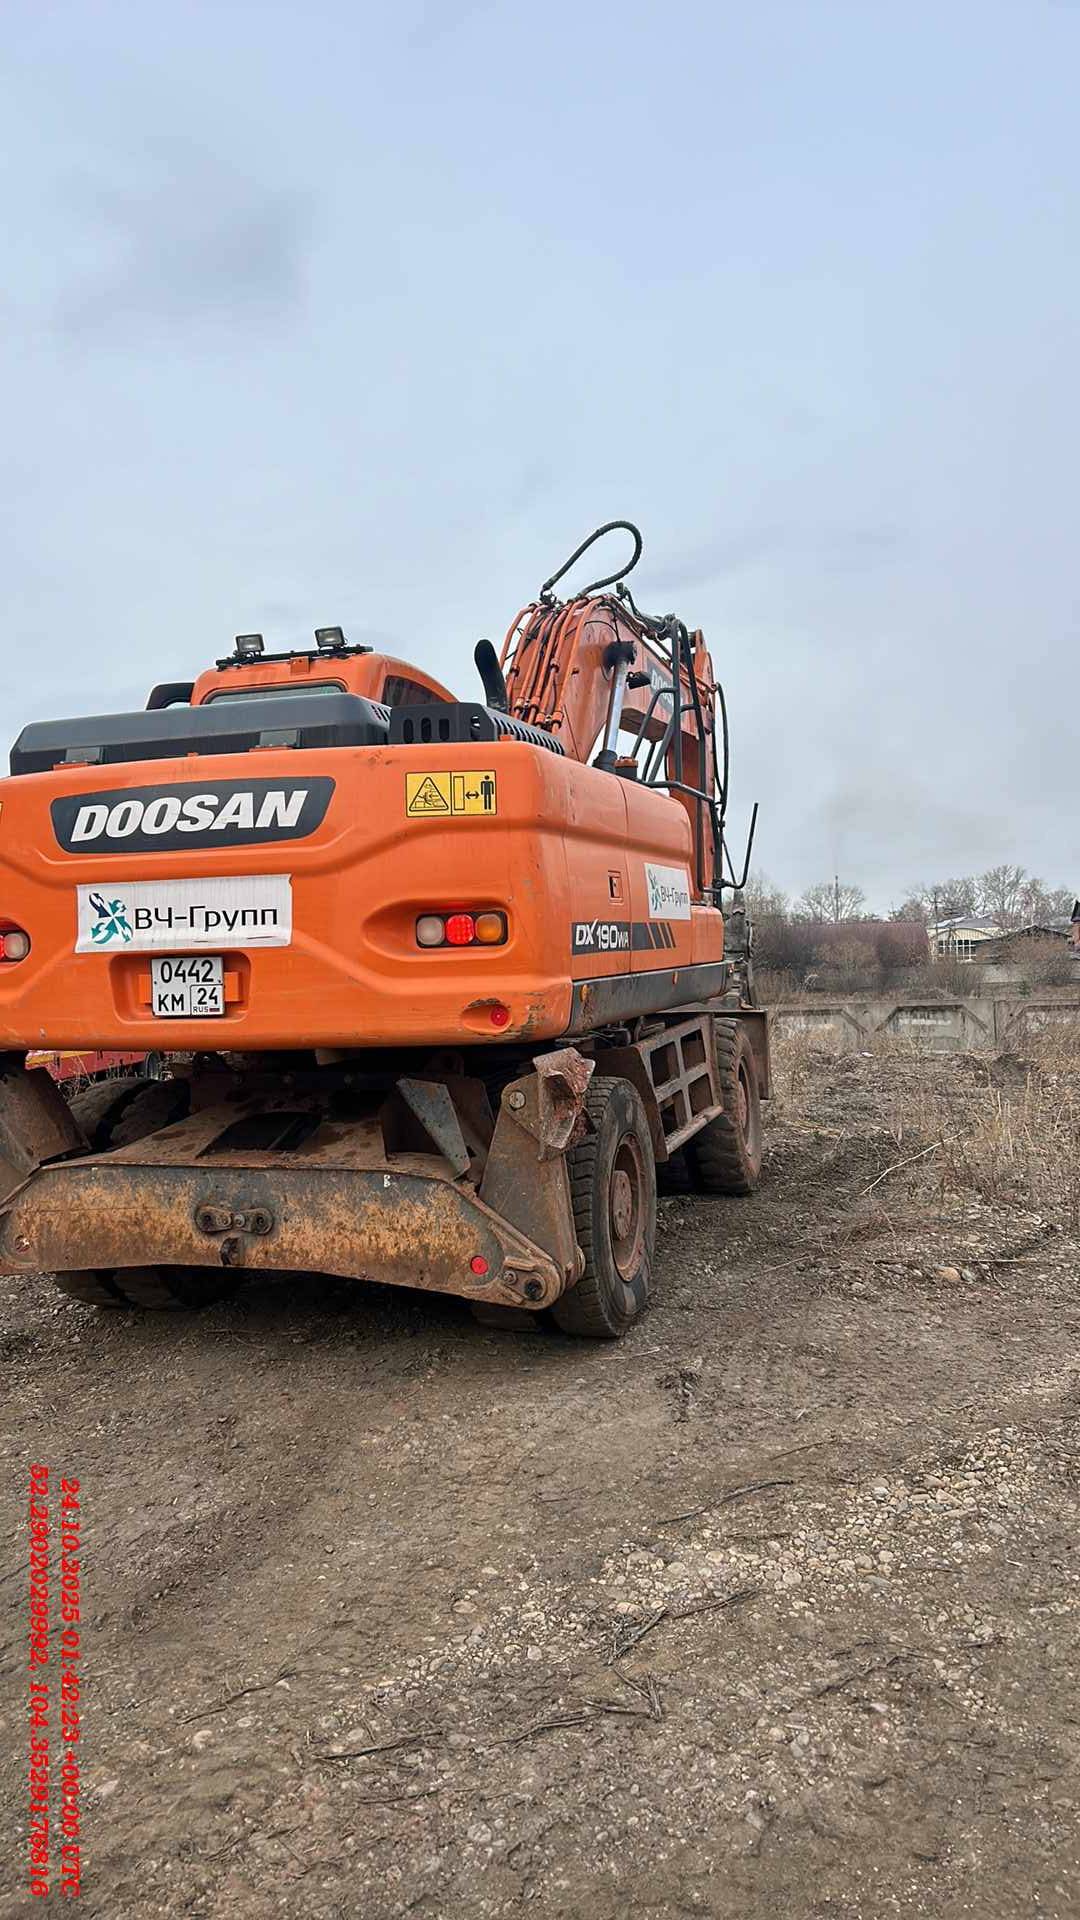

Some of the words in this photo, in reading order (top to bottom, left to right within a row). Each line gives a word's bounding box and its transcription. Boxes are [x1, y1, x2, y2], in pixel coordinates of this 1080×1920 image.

[70, 790, 309, 843] DOOSAN
[134, 905, 279, 932] ВЧ-Групп
[160, 959, 214, 983] 0442
[197, 987, 218, 1005] 24
